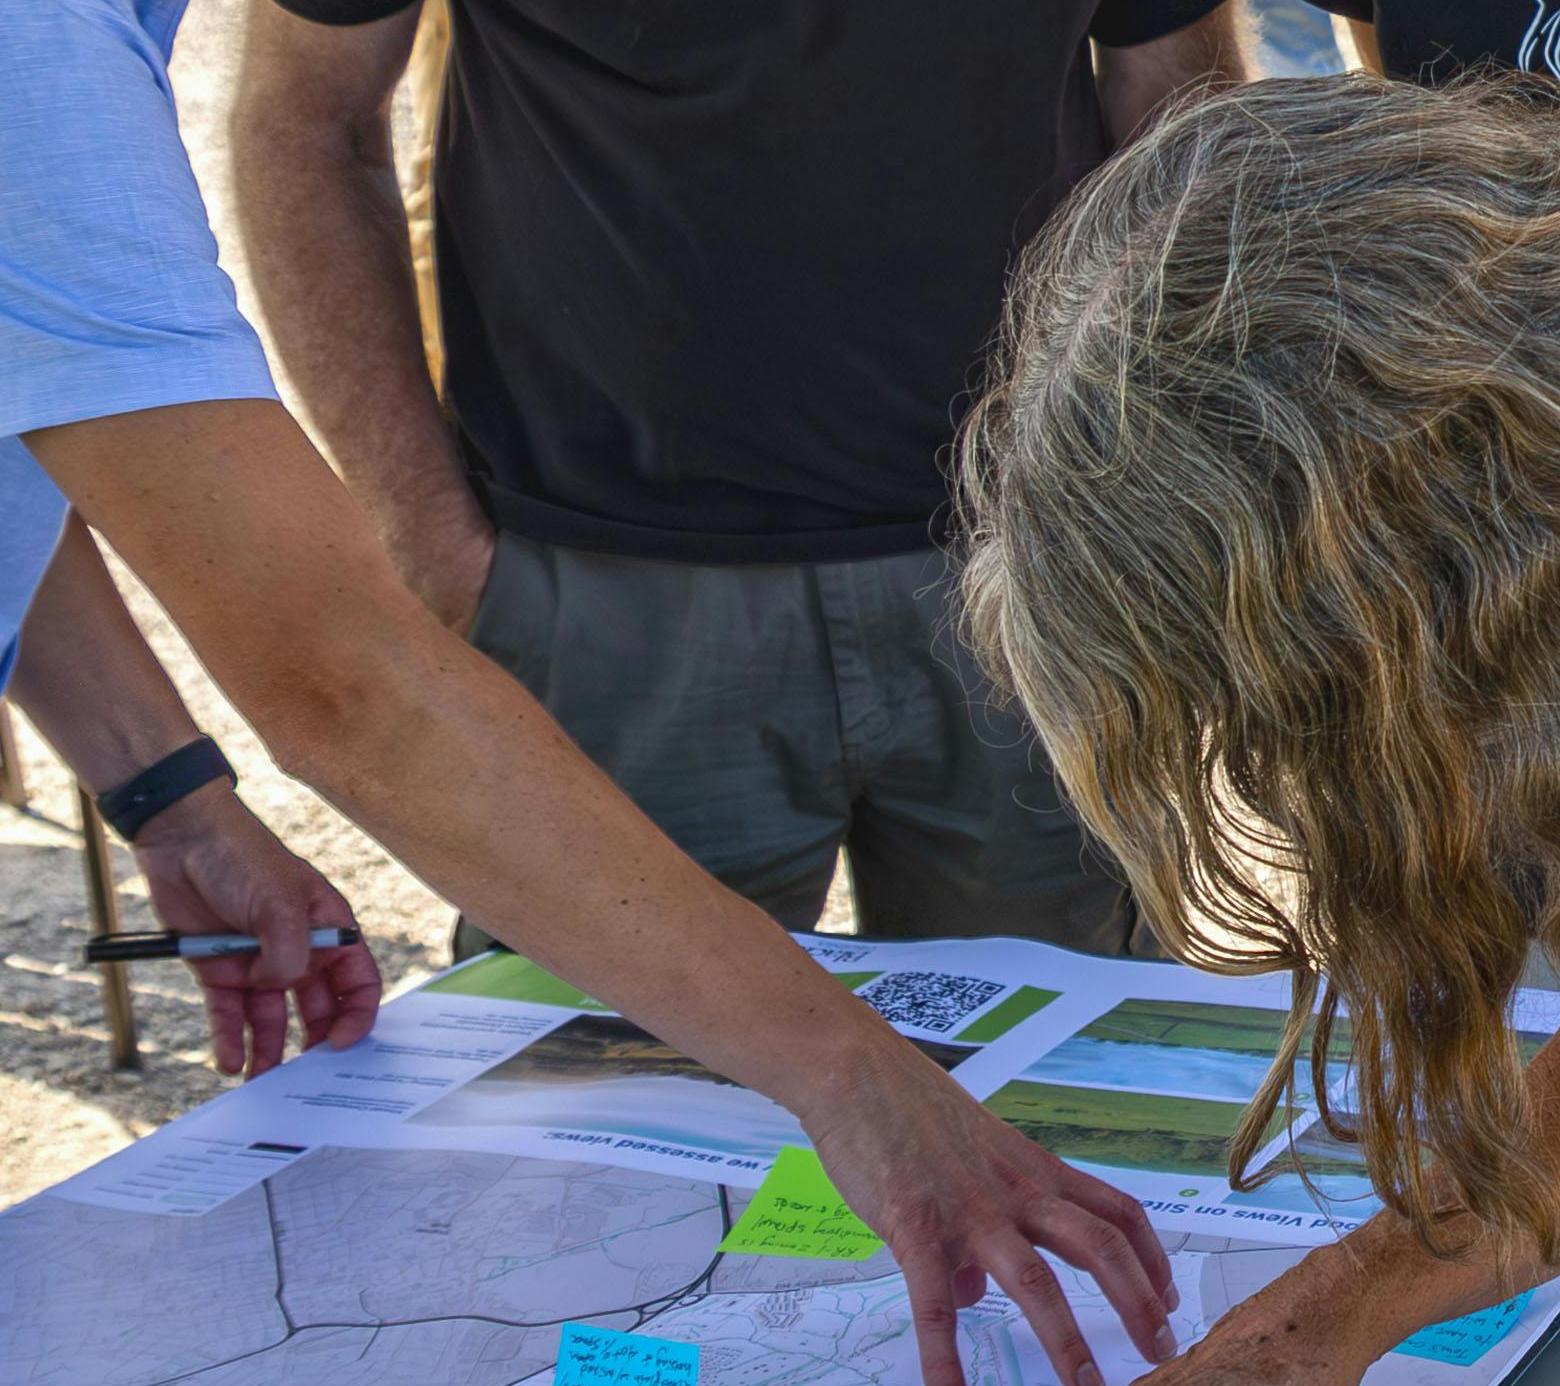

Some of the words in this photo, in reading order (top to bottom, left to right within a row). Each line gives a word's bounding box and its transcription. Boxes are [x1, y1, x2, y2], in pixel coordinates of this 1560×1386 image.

[543, 1131, 610, 1146] views:
[614, 1139, 724, 1164] assessed
[726, 1159, 760, 1171] we
[1194, 1206, 1226, 1218] on
[1233, 1208, 1303, 1226] Views
